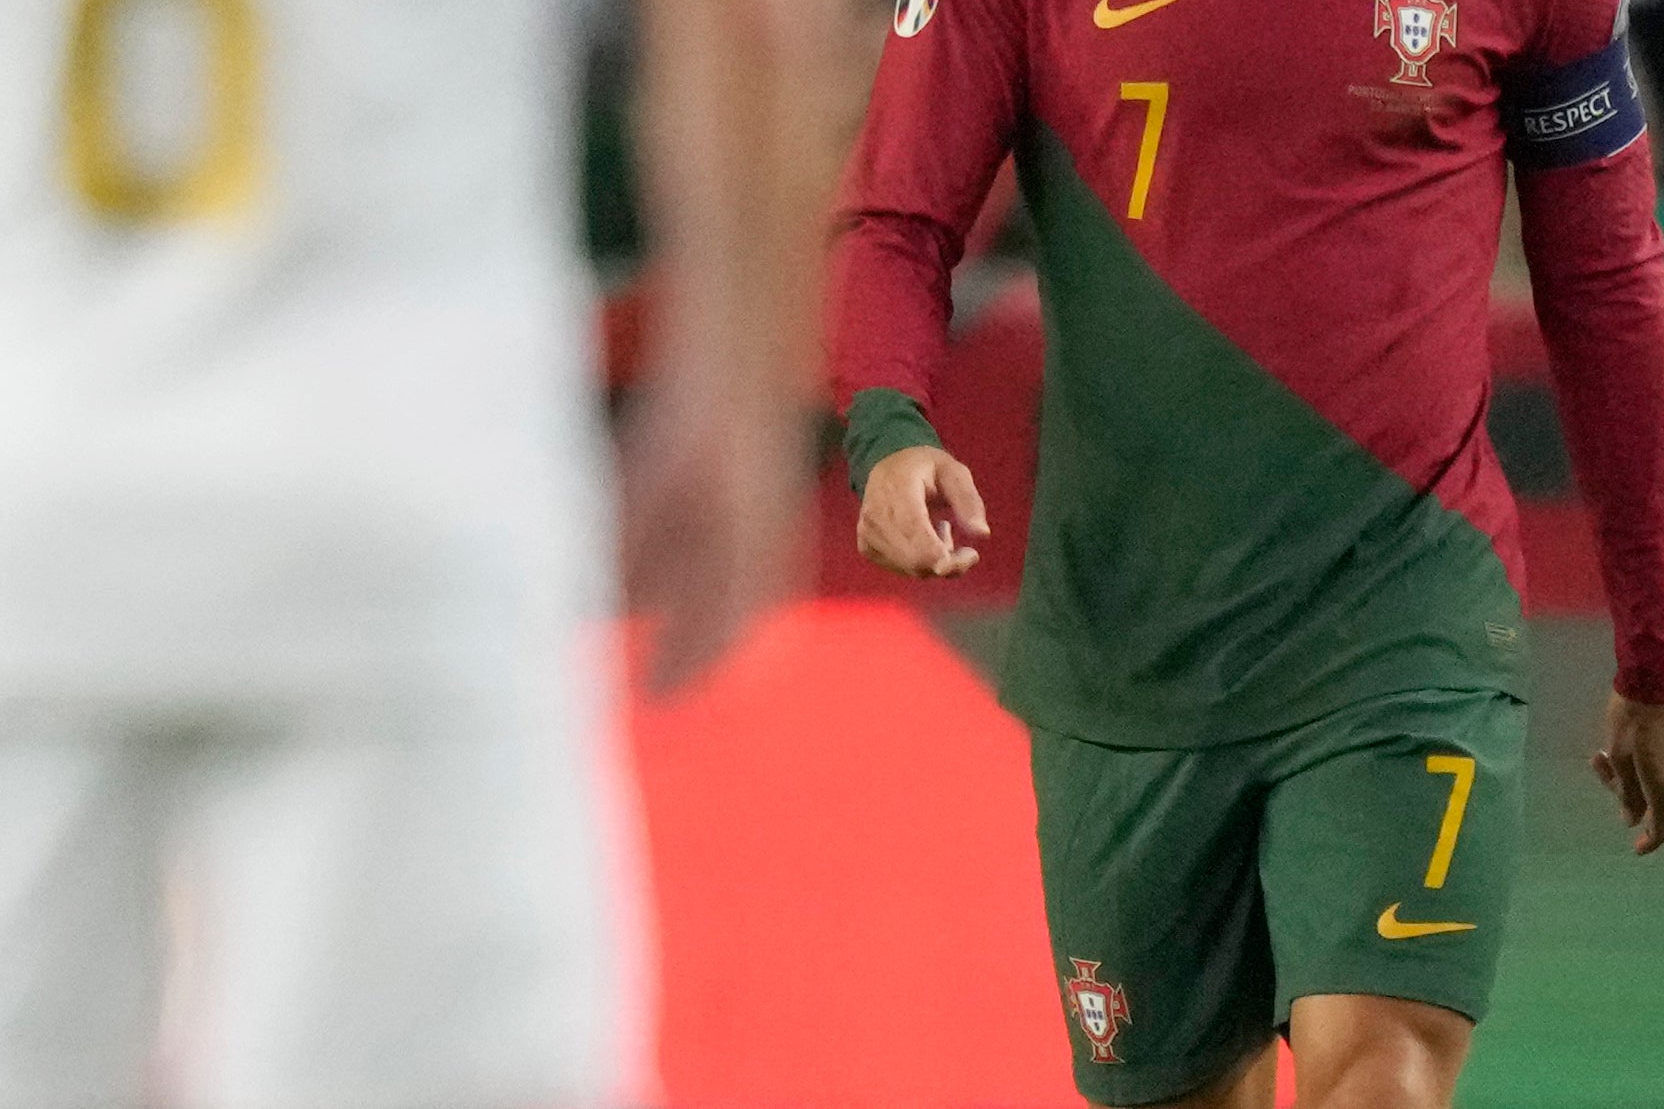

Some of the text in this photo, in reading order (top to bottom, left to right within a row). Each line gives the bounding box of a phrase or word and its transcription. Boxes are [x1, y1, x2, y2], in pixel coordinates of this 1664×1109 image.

[1120, 81, 1169, 221] 7
[1524, 87, 1613, 136] RESPECT
[1425, 755, 1476, 889] 7
